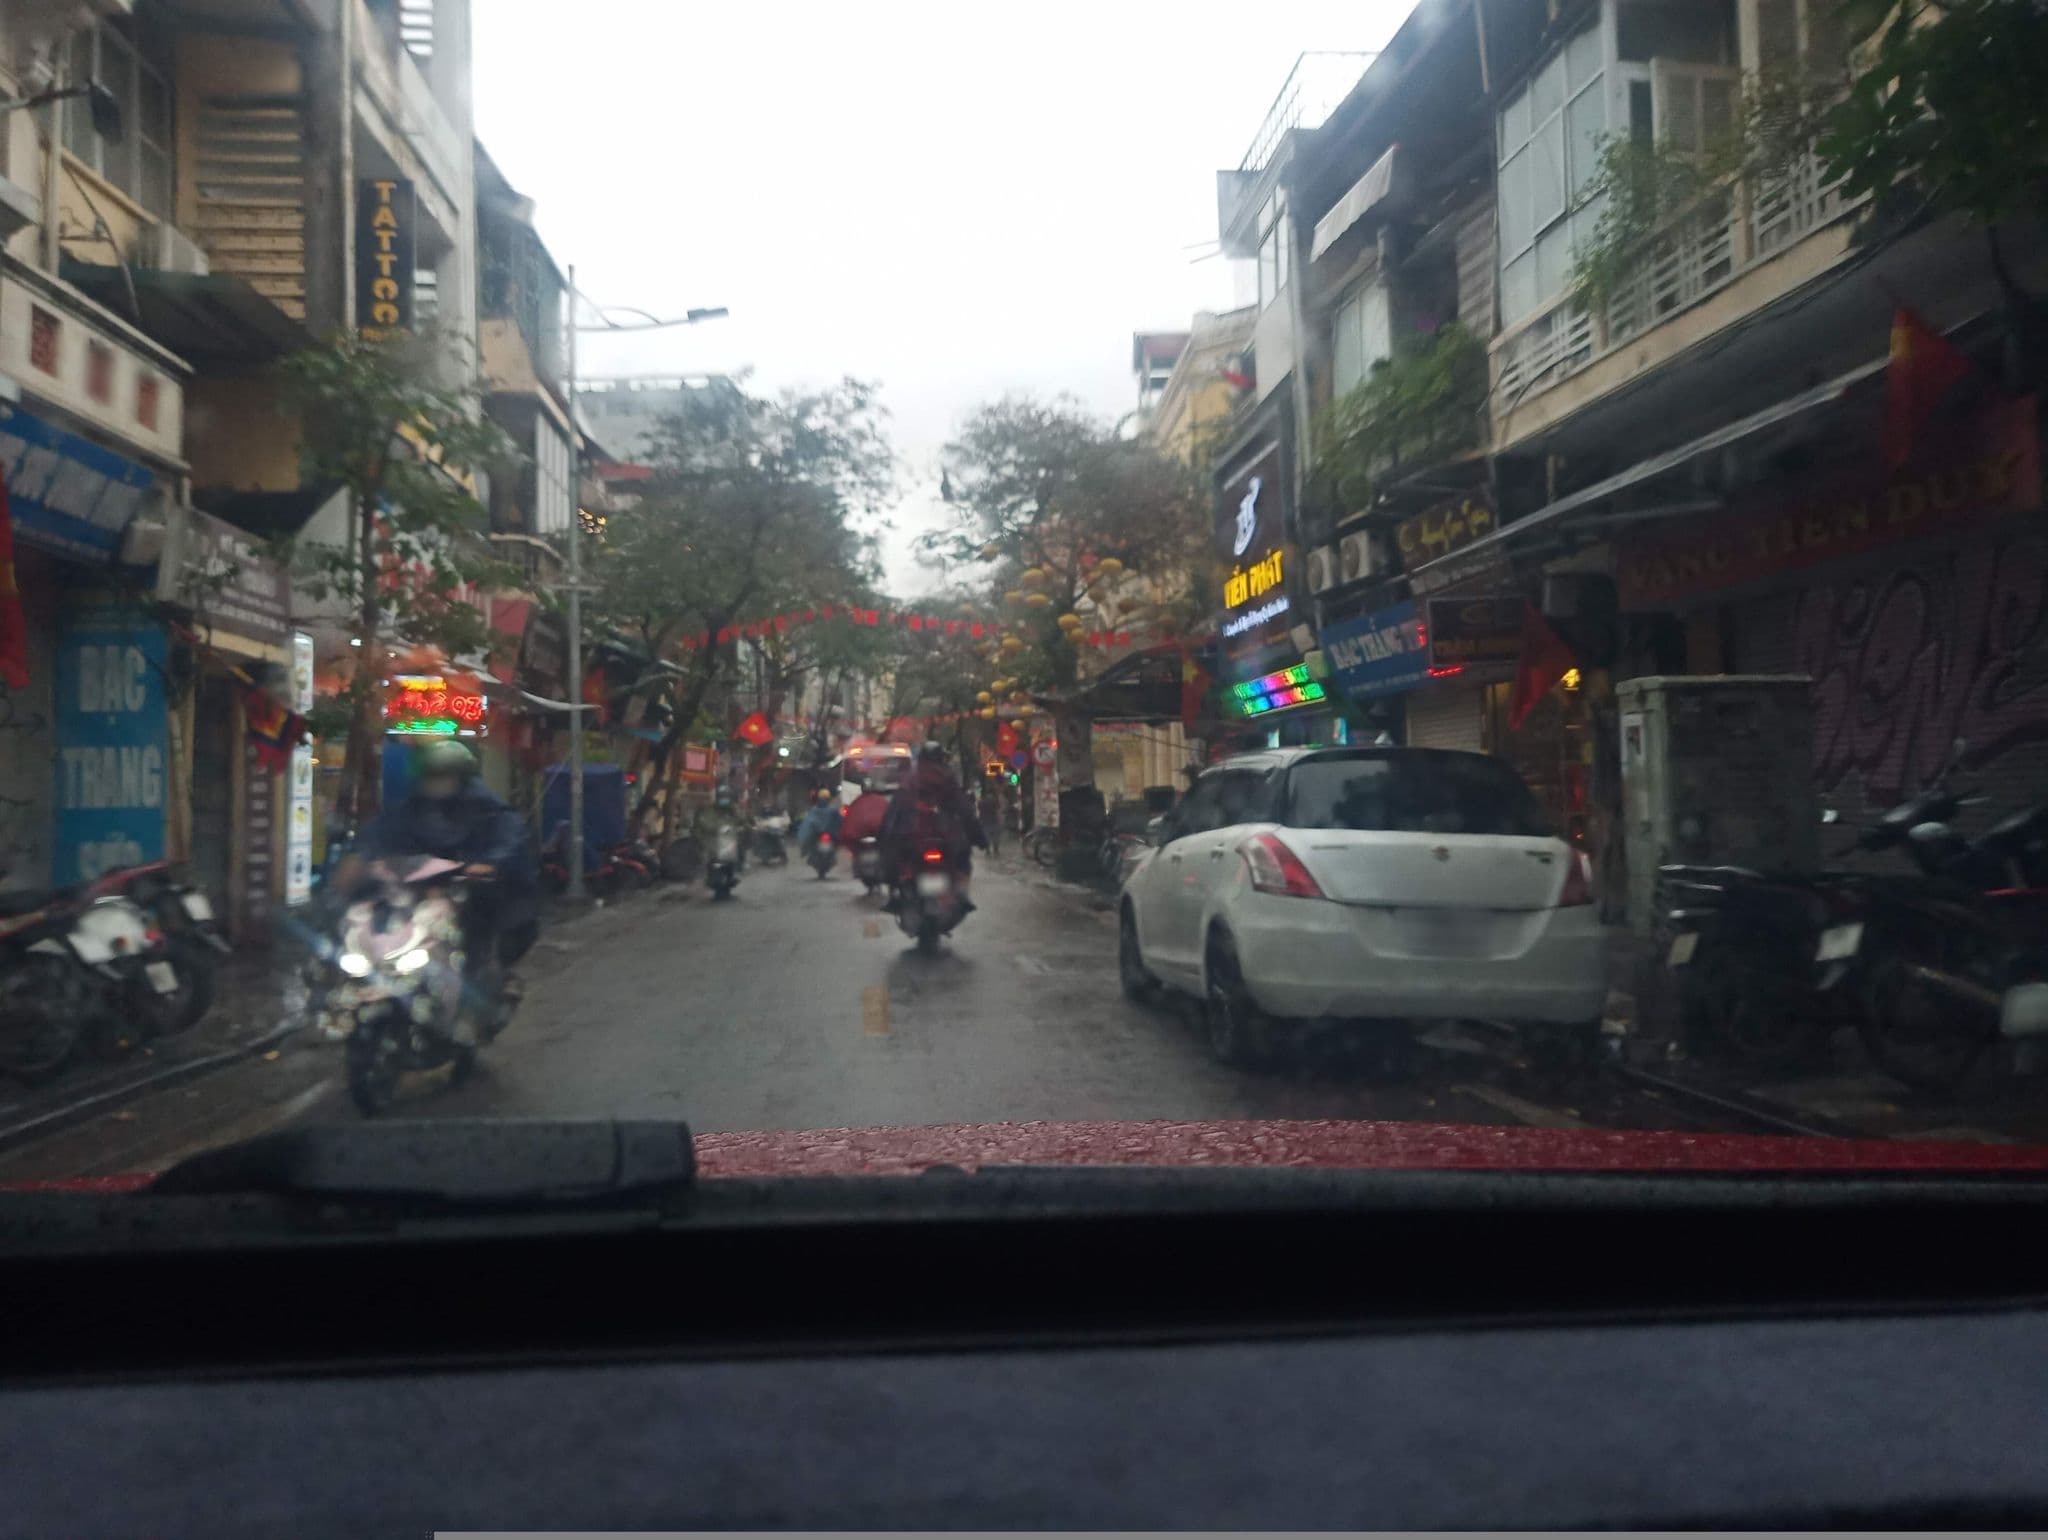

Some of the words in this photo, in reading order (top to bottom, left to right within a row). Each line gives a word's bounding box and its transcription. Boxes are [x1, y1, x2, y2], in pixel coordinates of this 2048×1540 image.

[371, 181, 399, 324] TATTOO
[78, 645, 148, 726] BẠC
[61, 745, 162, 810] TRANG
